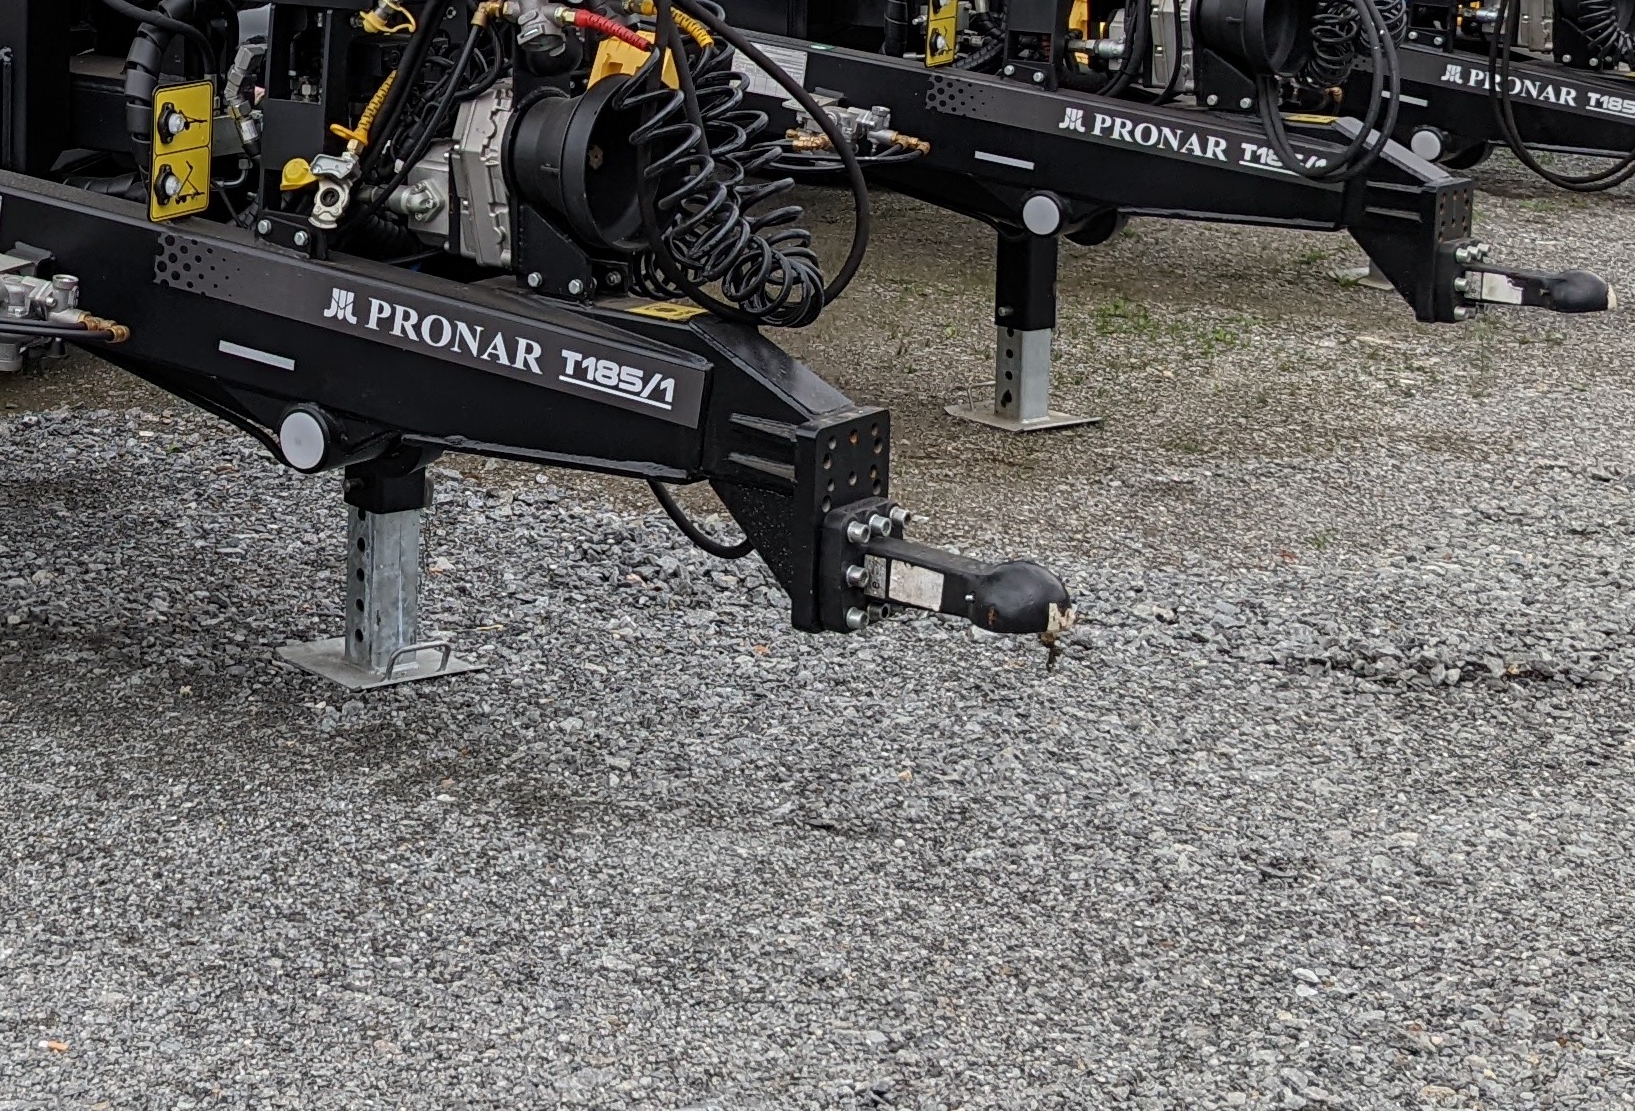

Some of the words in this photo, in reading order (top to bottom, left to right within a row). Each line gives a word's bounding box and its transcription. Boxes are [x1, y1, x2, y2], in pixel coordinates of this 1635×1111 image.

[1467, 68, 1577, 107] PRONAR
[1091, 112, 1228, 161] PRONAR
[1240, 142, 1328, 169] T18/
[364, 297, 543, 375] PRONAR
[561, 349, 676, 403] T185/1
